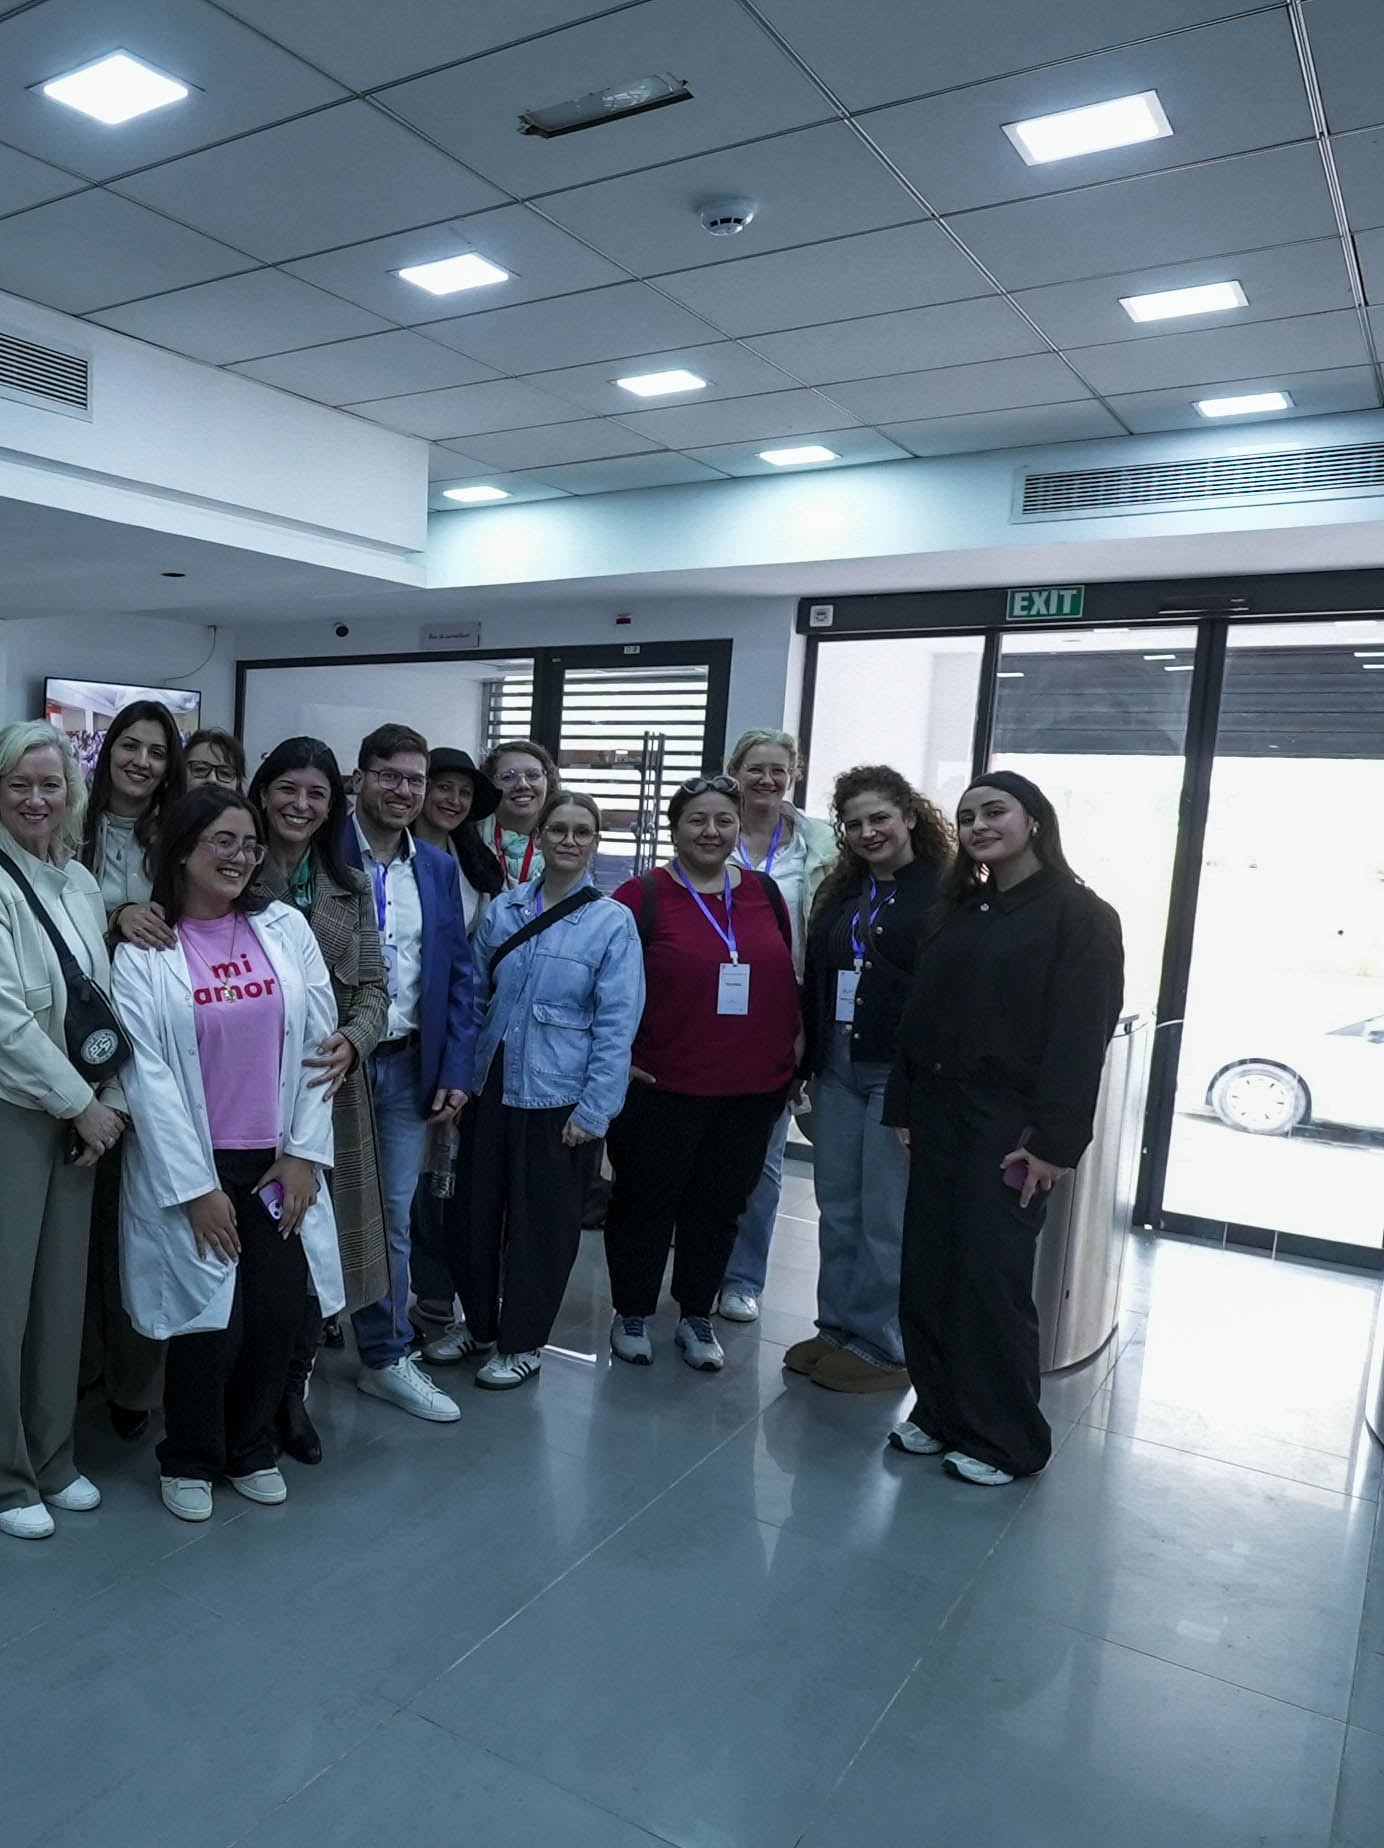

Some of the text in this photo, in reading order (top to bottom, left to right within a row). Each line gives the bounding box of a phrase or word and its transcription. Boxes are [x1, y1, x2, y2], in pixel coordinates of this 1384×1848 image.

[1013, 589, 1077, 616] EXIT
[211, 953, 252, 979] mi
[193, 978, 275, 1006] amor
